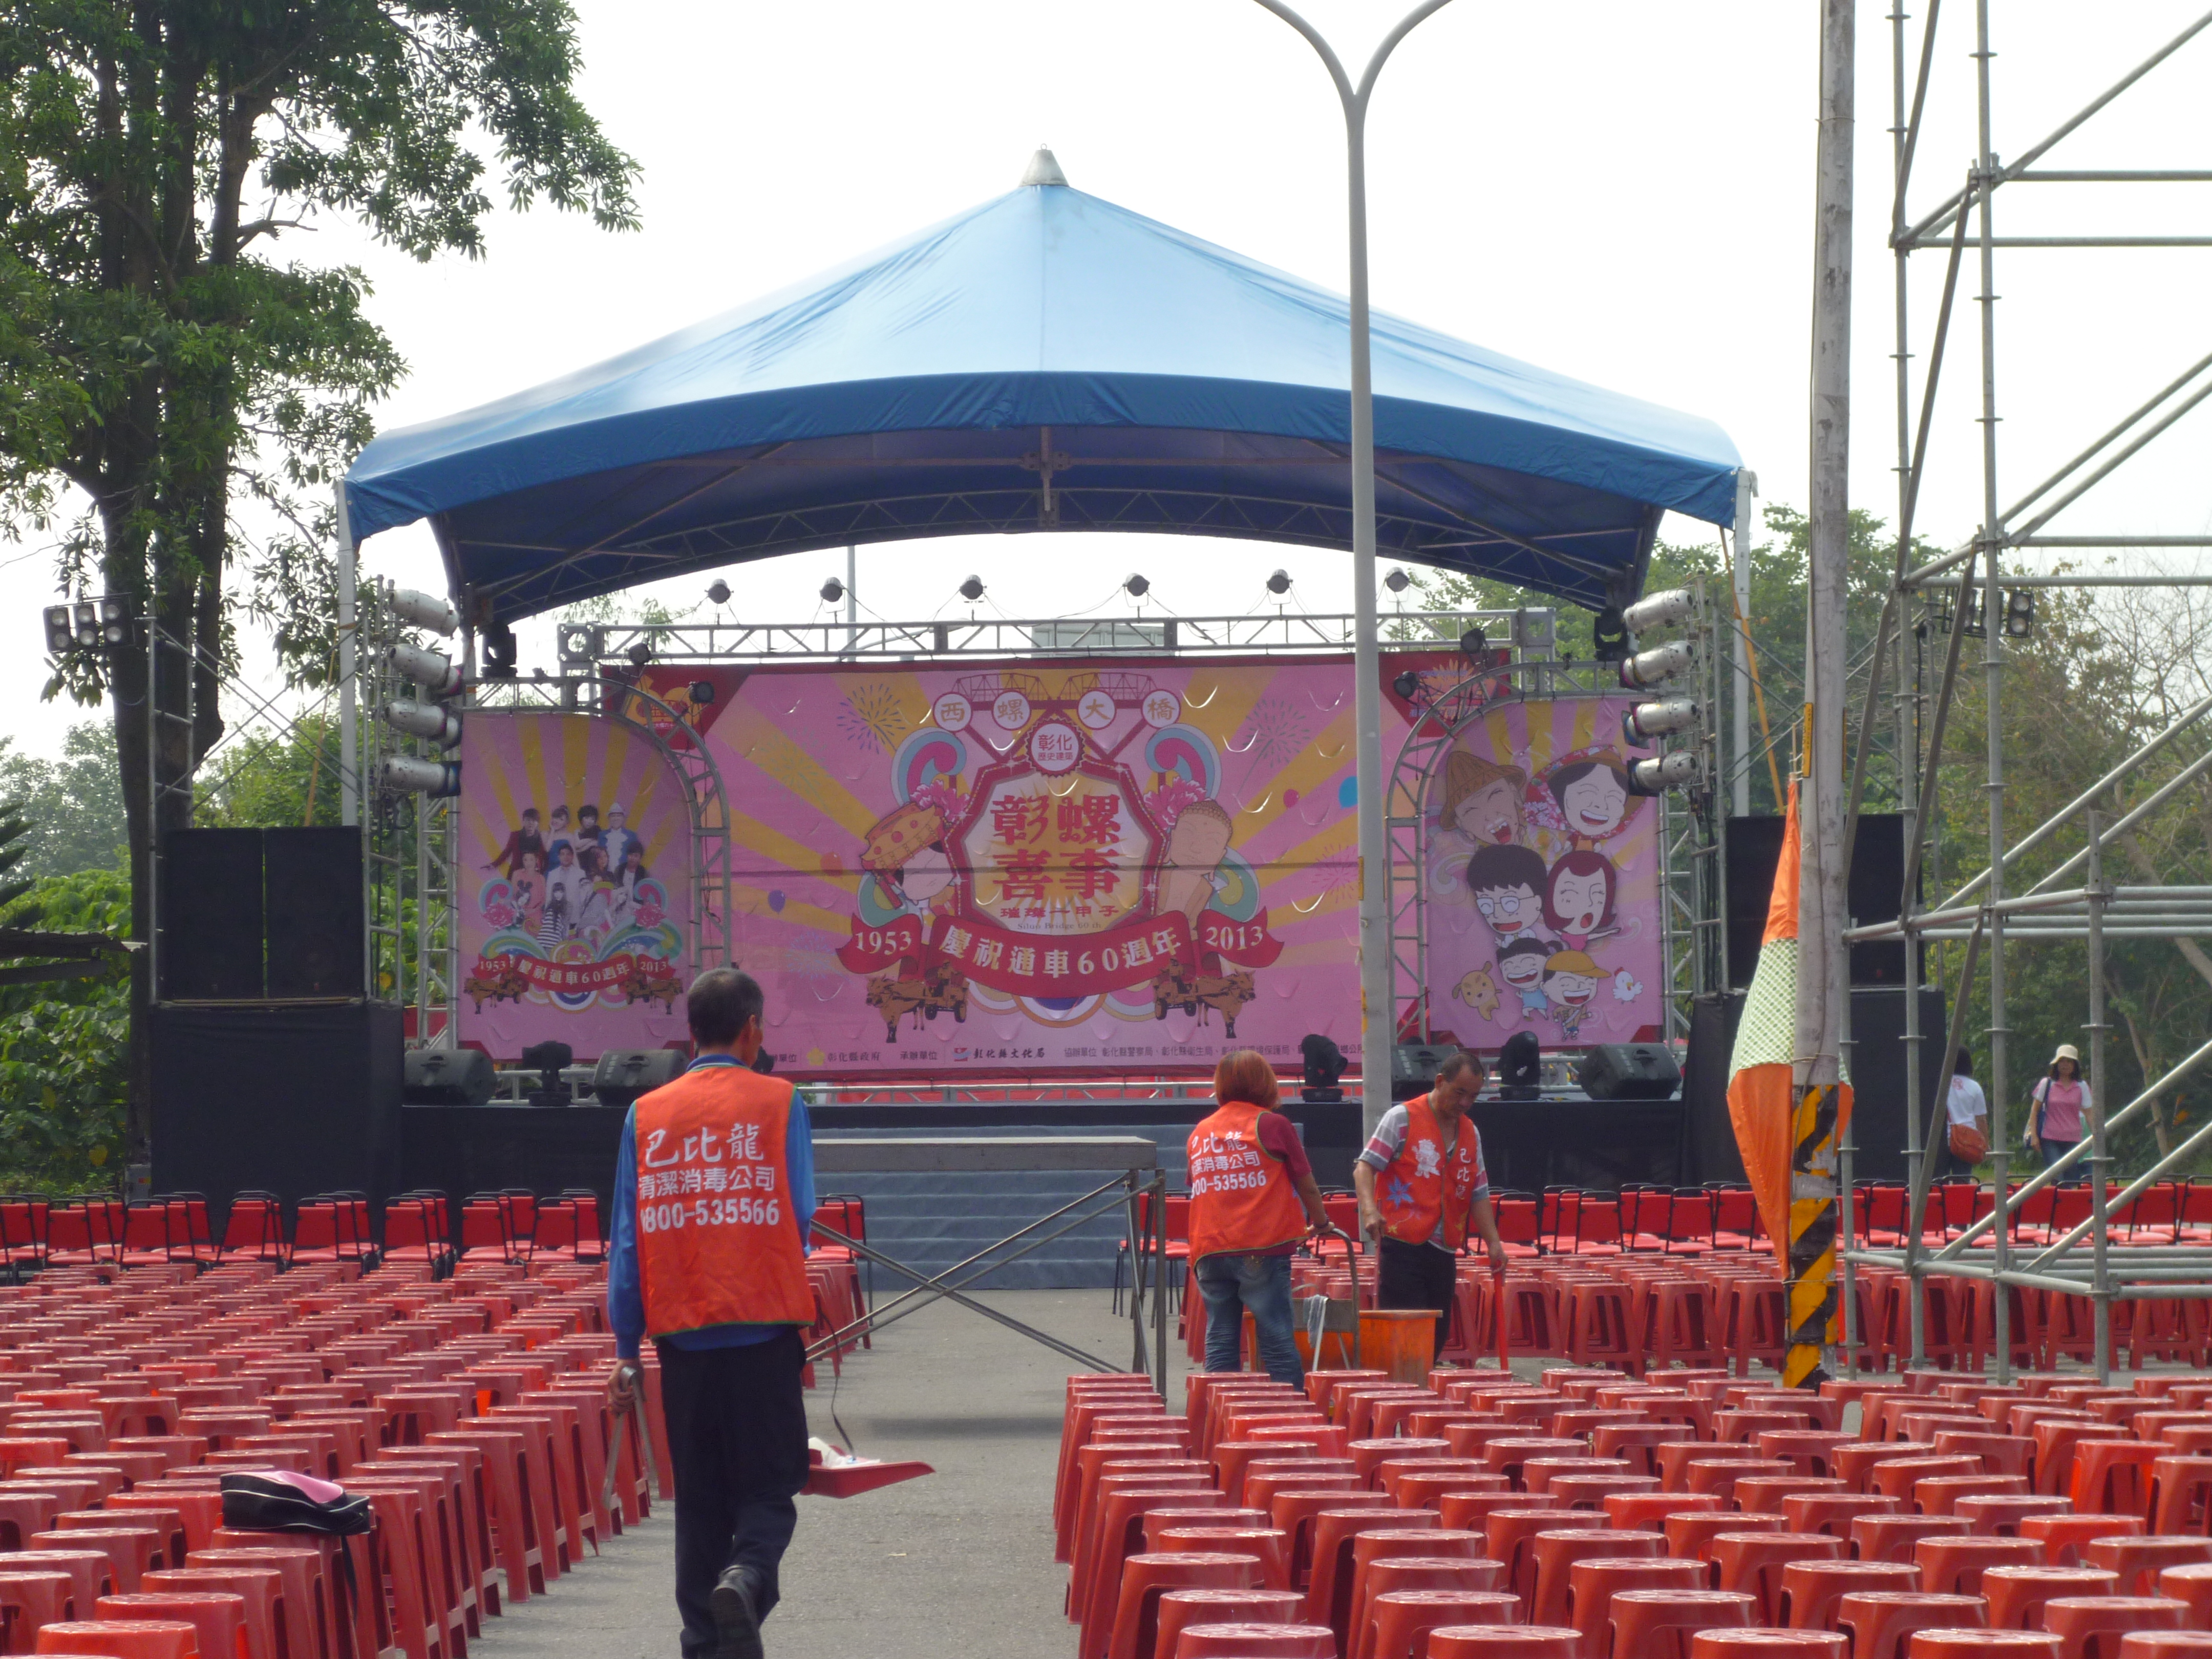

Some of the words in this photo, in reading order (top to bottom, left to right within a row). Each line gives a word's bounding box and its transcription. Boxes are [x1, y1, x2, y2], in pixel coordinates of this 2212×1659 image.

[1038, 734, 1073, 751] 彰化
[1038, 752, 1073, 761] 歷史建築
[990, 794, 1121, 845] 彰螺
[992, 848, 1121, 901] 喜事
[1000, 905, 1119, 919] 璀璨一甲子
[1044, 922, 1075, 930] Bridge
[856, 930, 912, 955] 1953
[1206, 925, 1264, 951] 2013
[939, 924, 1182, 979] 慶祝通車60週年
[479, 961, 506, 971] 1953
[640, 961, 667, 973] 2013
